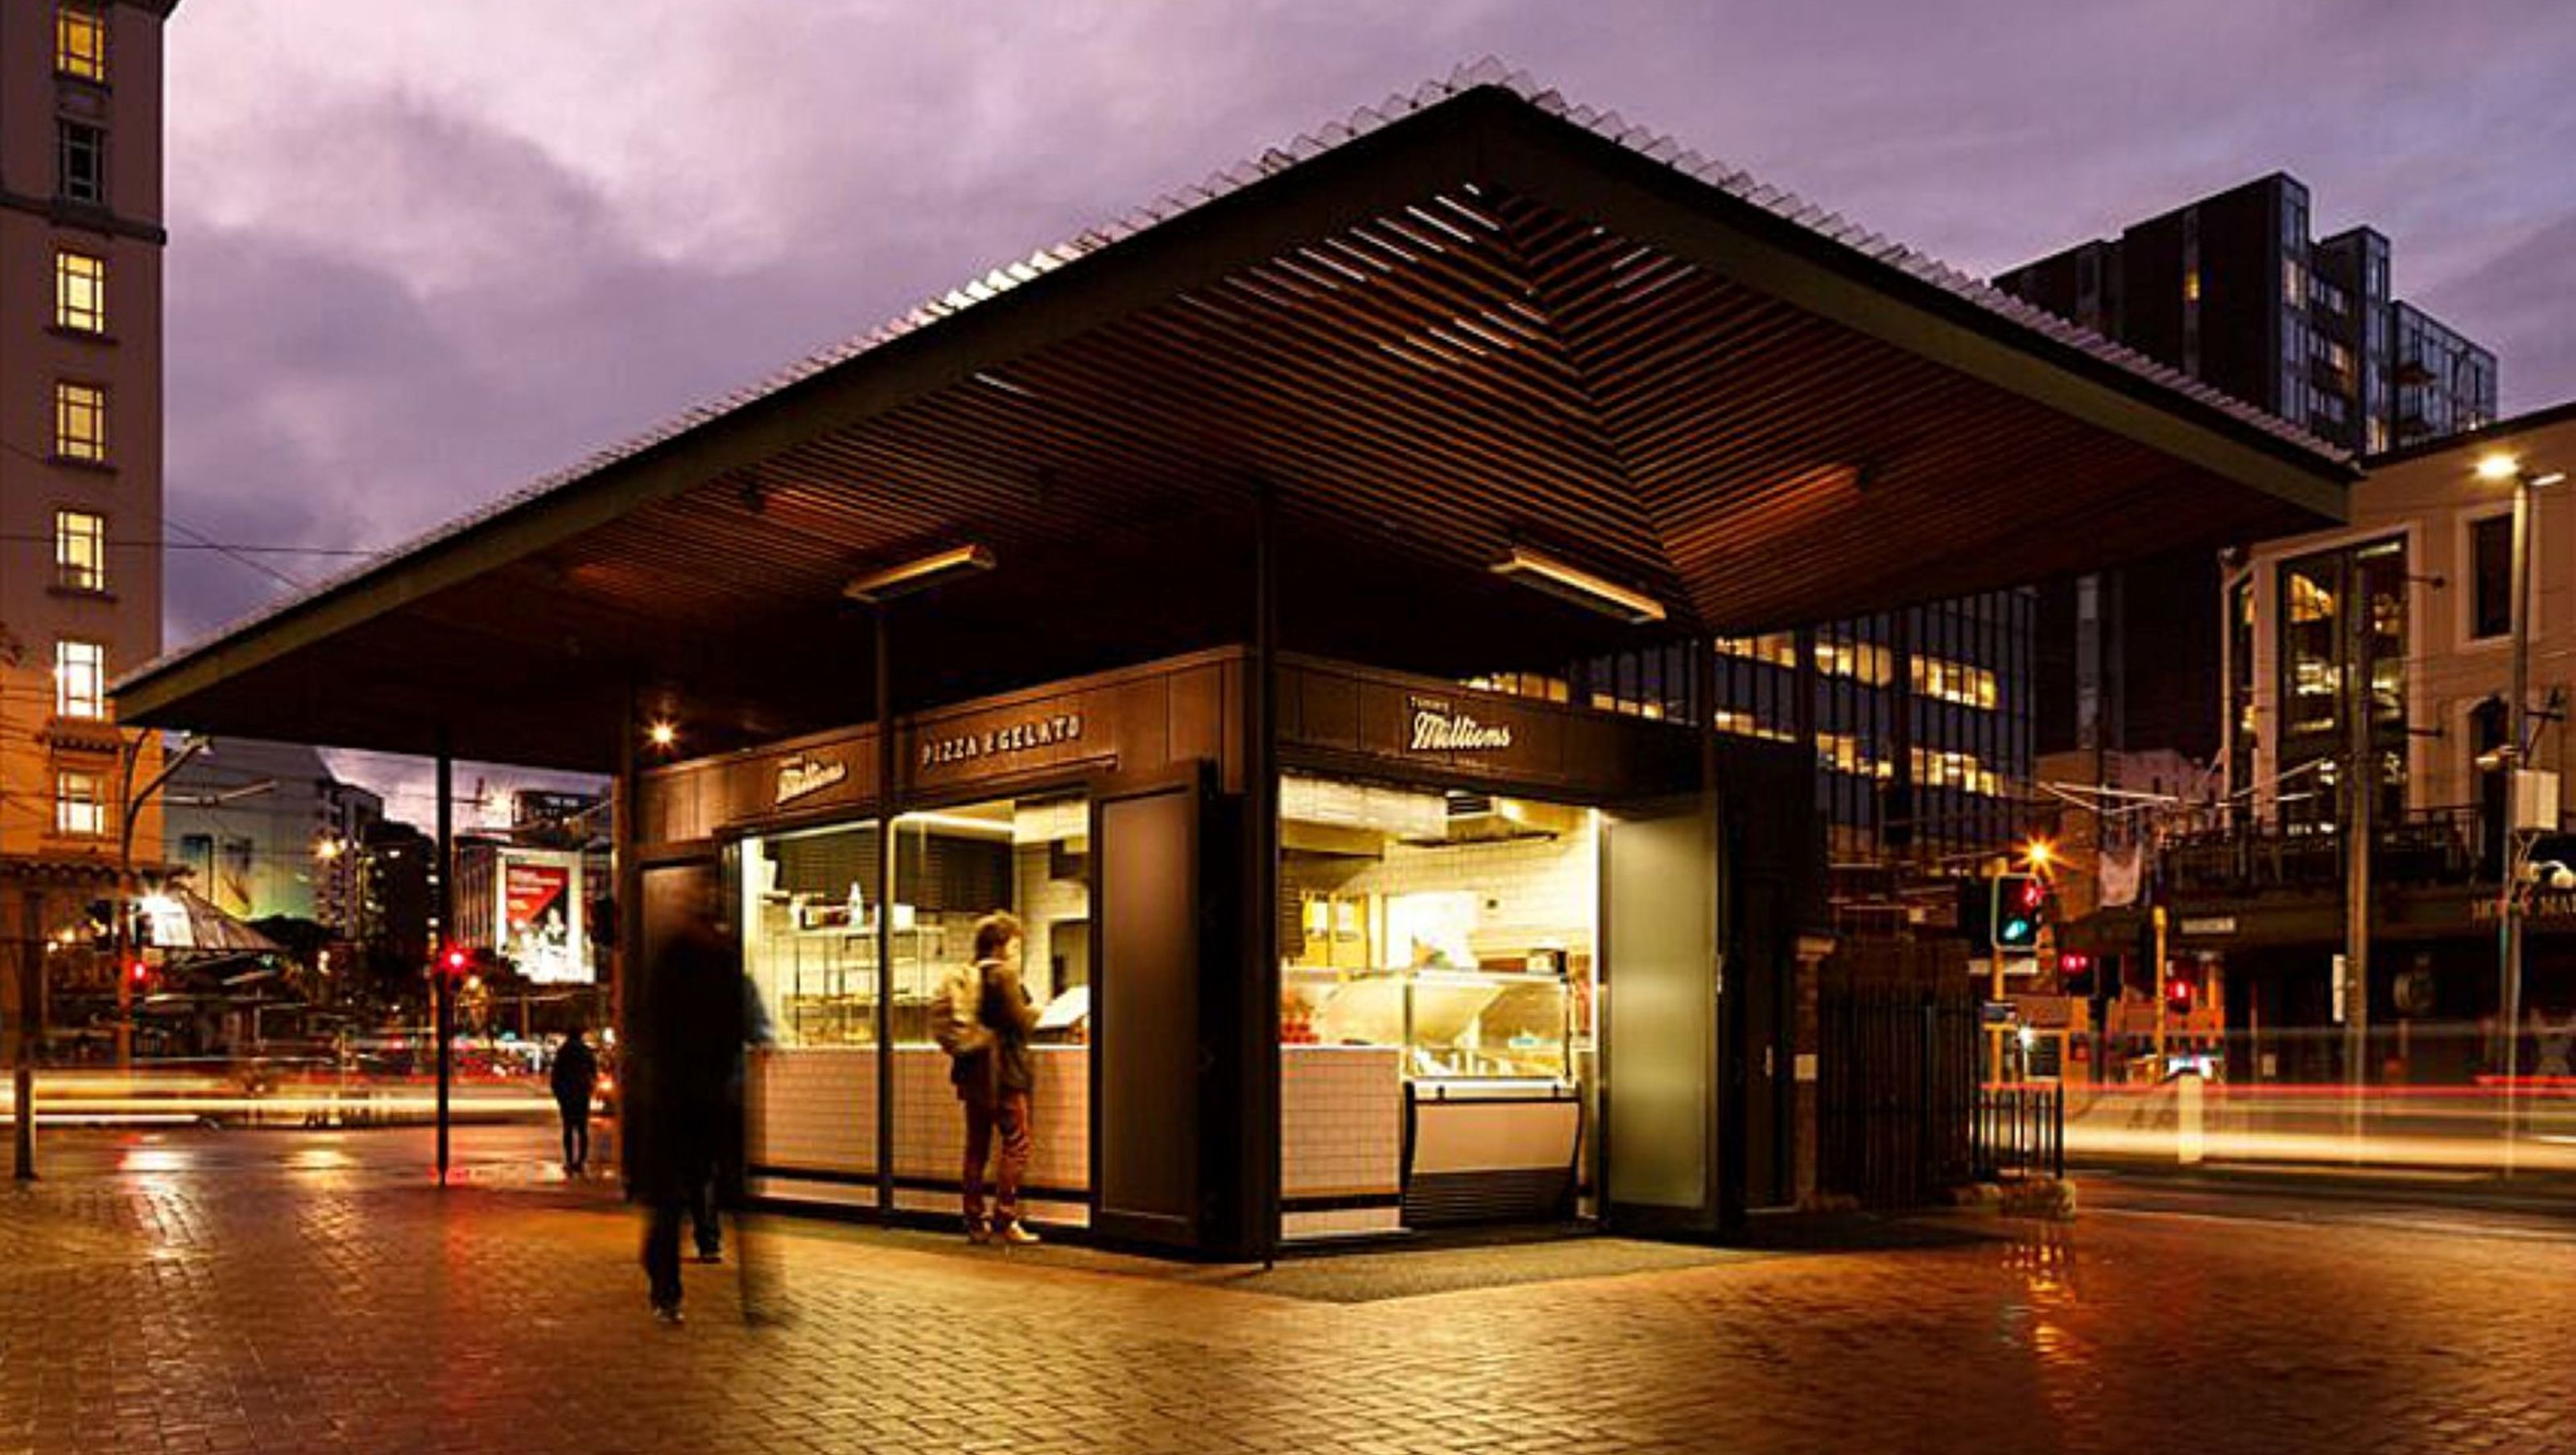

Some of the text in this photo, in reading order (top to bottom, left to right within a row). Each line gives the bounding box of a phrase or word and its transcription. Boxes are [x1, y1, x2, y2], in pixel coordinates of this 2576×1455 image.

[923, 735, 976, 766] PIZZA
[997, 715, 1080, 750] GELATO
[1411, 712, 1512, 749] Millions
